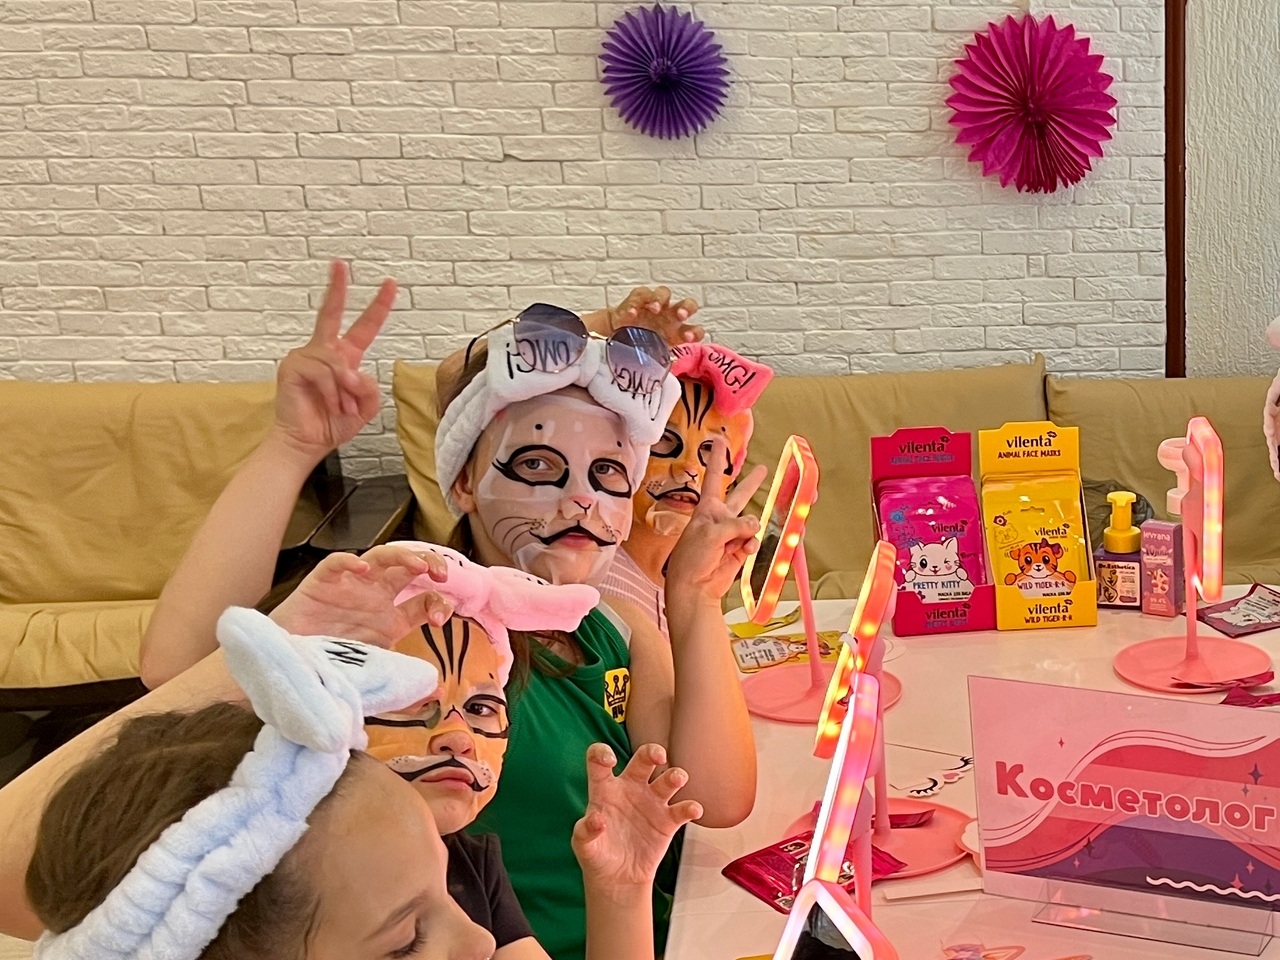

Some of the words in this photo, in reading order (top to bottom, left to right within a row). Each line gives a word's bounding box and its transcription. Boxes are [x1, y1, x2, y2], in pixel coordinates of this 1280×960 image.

[707, 351, 756, 394] OMG!
[899, 441, 945, 454] vilenta
[1006, 435, 1052, 448] vilenta
[998, 451, 1021, 459] ANIMAL
[1022, 450, 1038, 458] FACE
[1040, 449, 1061, 457] MASKS
[912, 581, 938, 590] PRETTY
[941, 580, 961, 588] KITTY
[1017, 582, 1033, 590] WILD
[925, 607, 967, 619] vilenta
[1028, 603, 1069, 615] vilenta
[1024, 616, 1041, 624] WILD
[995, 761, 1276, 831] Косметолог
